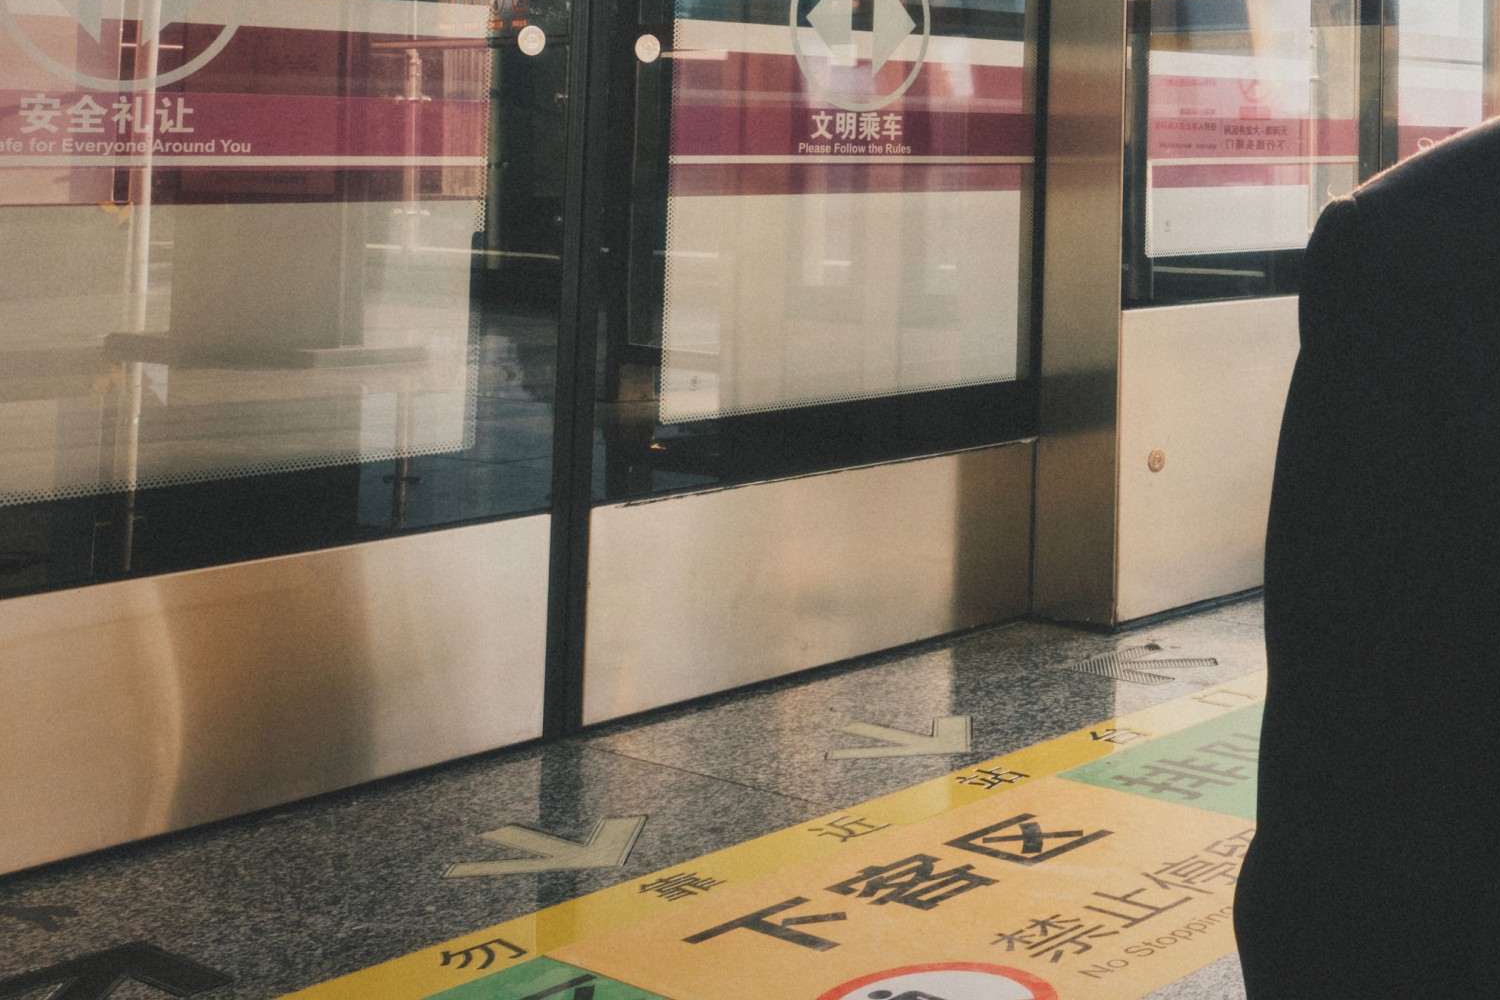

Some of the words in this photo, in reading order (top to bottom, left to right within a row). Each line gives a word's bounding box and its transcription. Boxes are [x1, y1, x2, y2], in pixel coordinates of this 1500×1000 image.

[18, 94, 194, 135] 安全礼让
[811, 111, 903, 141] 文明乘车
[0, 137, 23, 153] fe
[29, 138, 56, 153] for
[62, 138, 147, 156] Everyone
[152, 139, 215, 153] Around
[221, 139, 251, 153] You
[798, 143, 831, 153] Please
[834, 143, 866, 153] Follow
[868, 144, 883, 153] the
[886, 144, 911, 154] Rules
[680, 812, 1115, 952] 下客区
[1077, 957, 1129, 979] No
